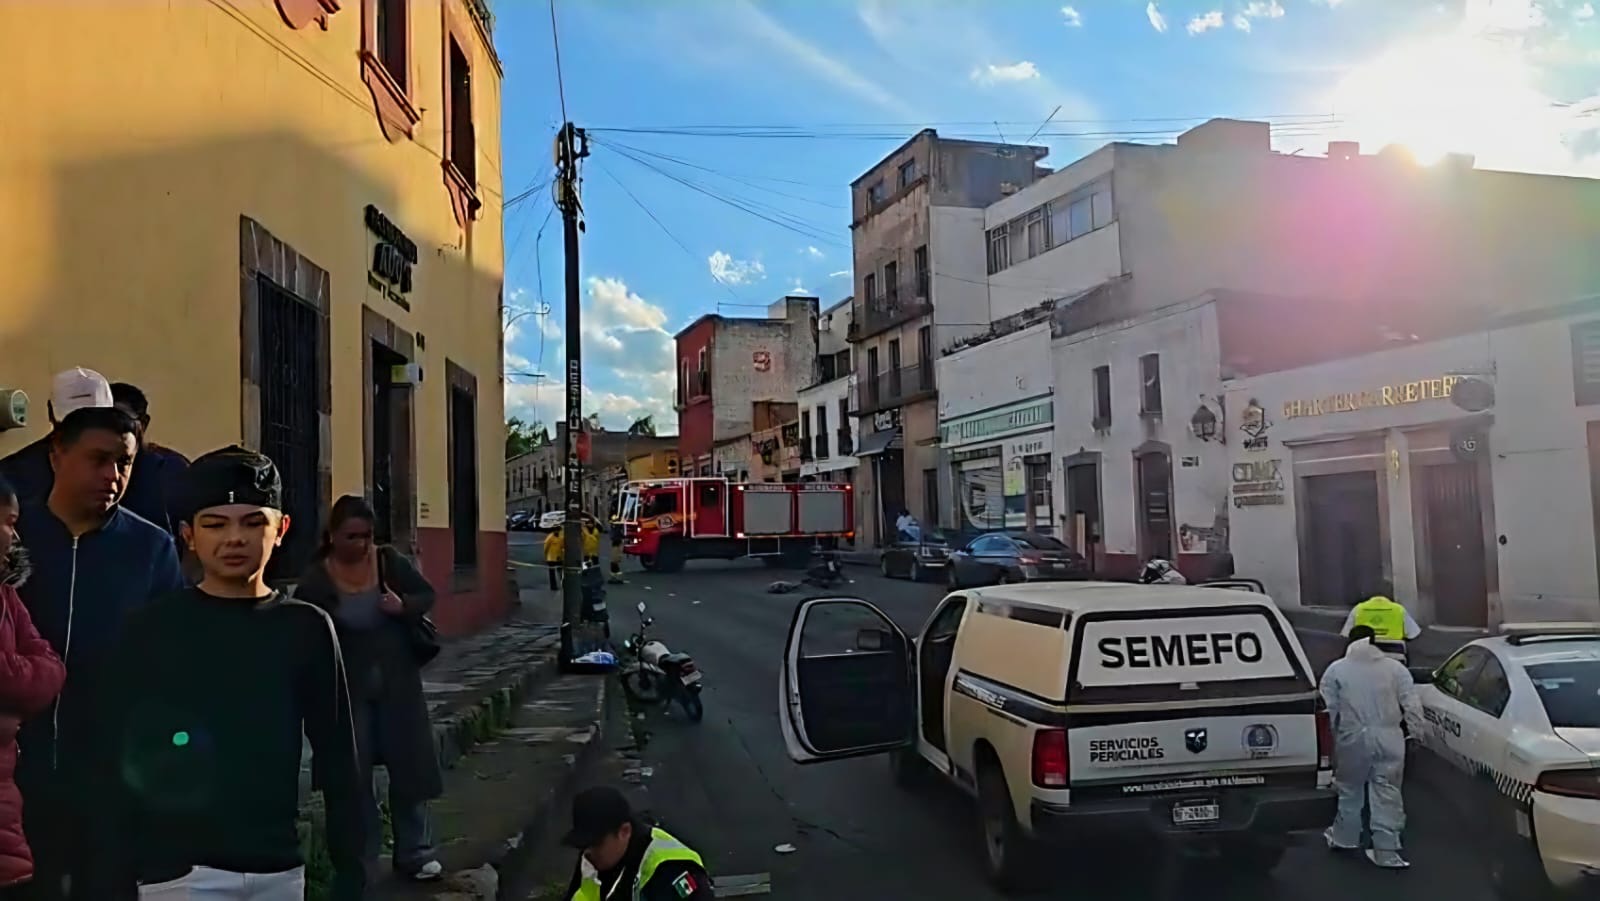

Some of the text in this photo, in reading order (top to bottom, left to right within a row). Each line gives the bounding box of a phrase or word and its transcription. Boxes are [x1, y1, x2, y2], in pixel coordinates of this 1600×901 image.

[1098, 632, 1262, 669] SEMEFO
[1090, 737, 1159, 751] SERVICIOS
[1090, 748, 1164, 762] PERICIALES
